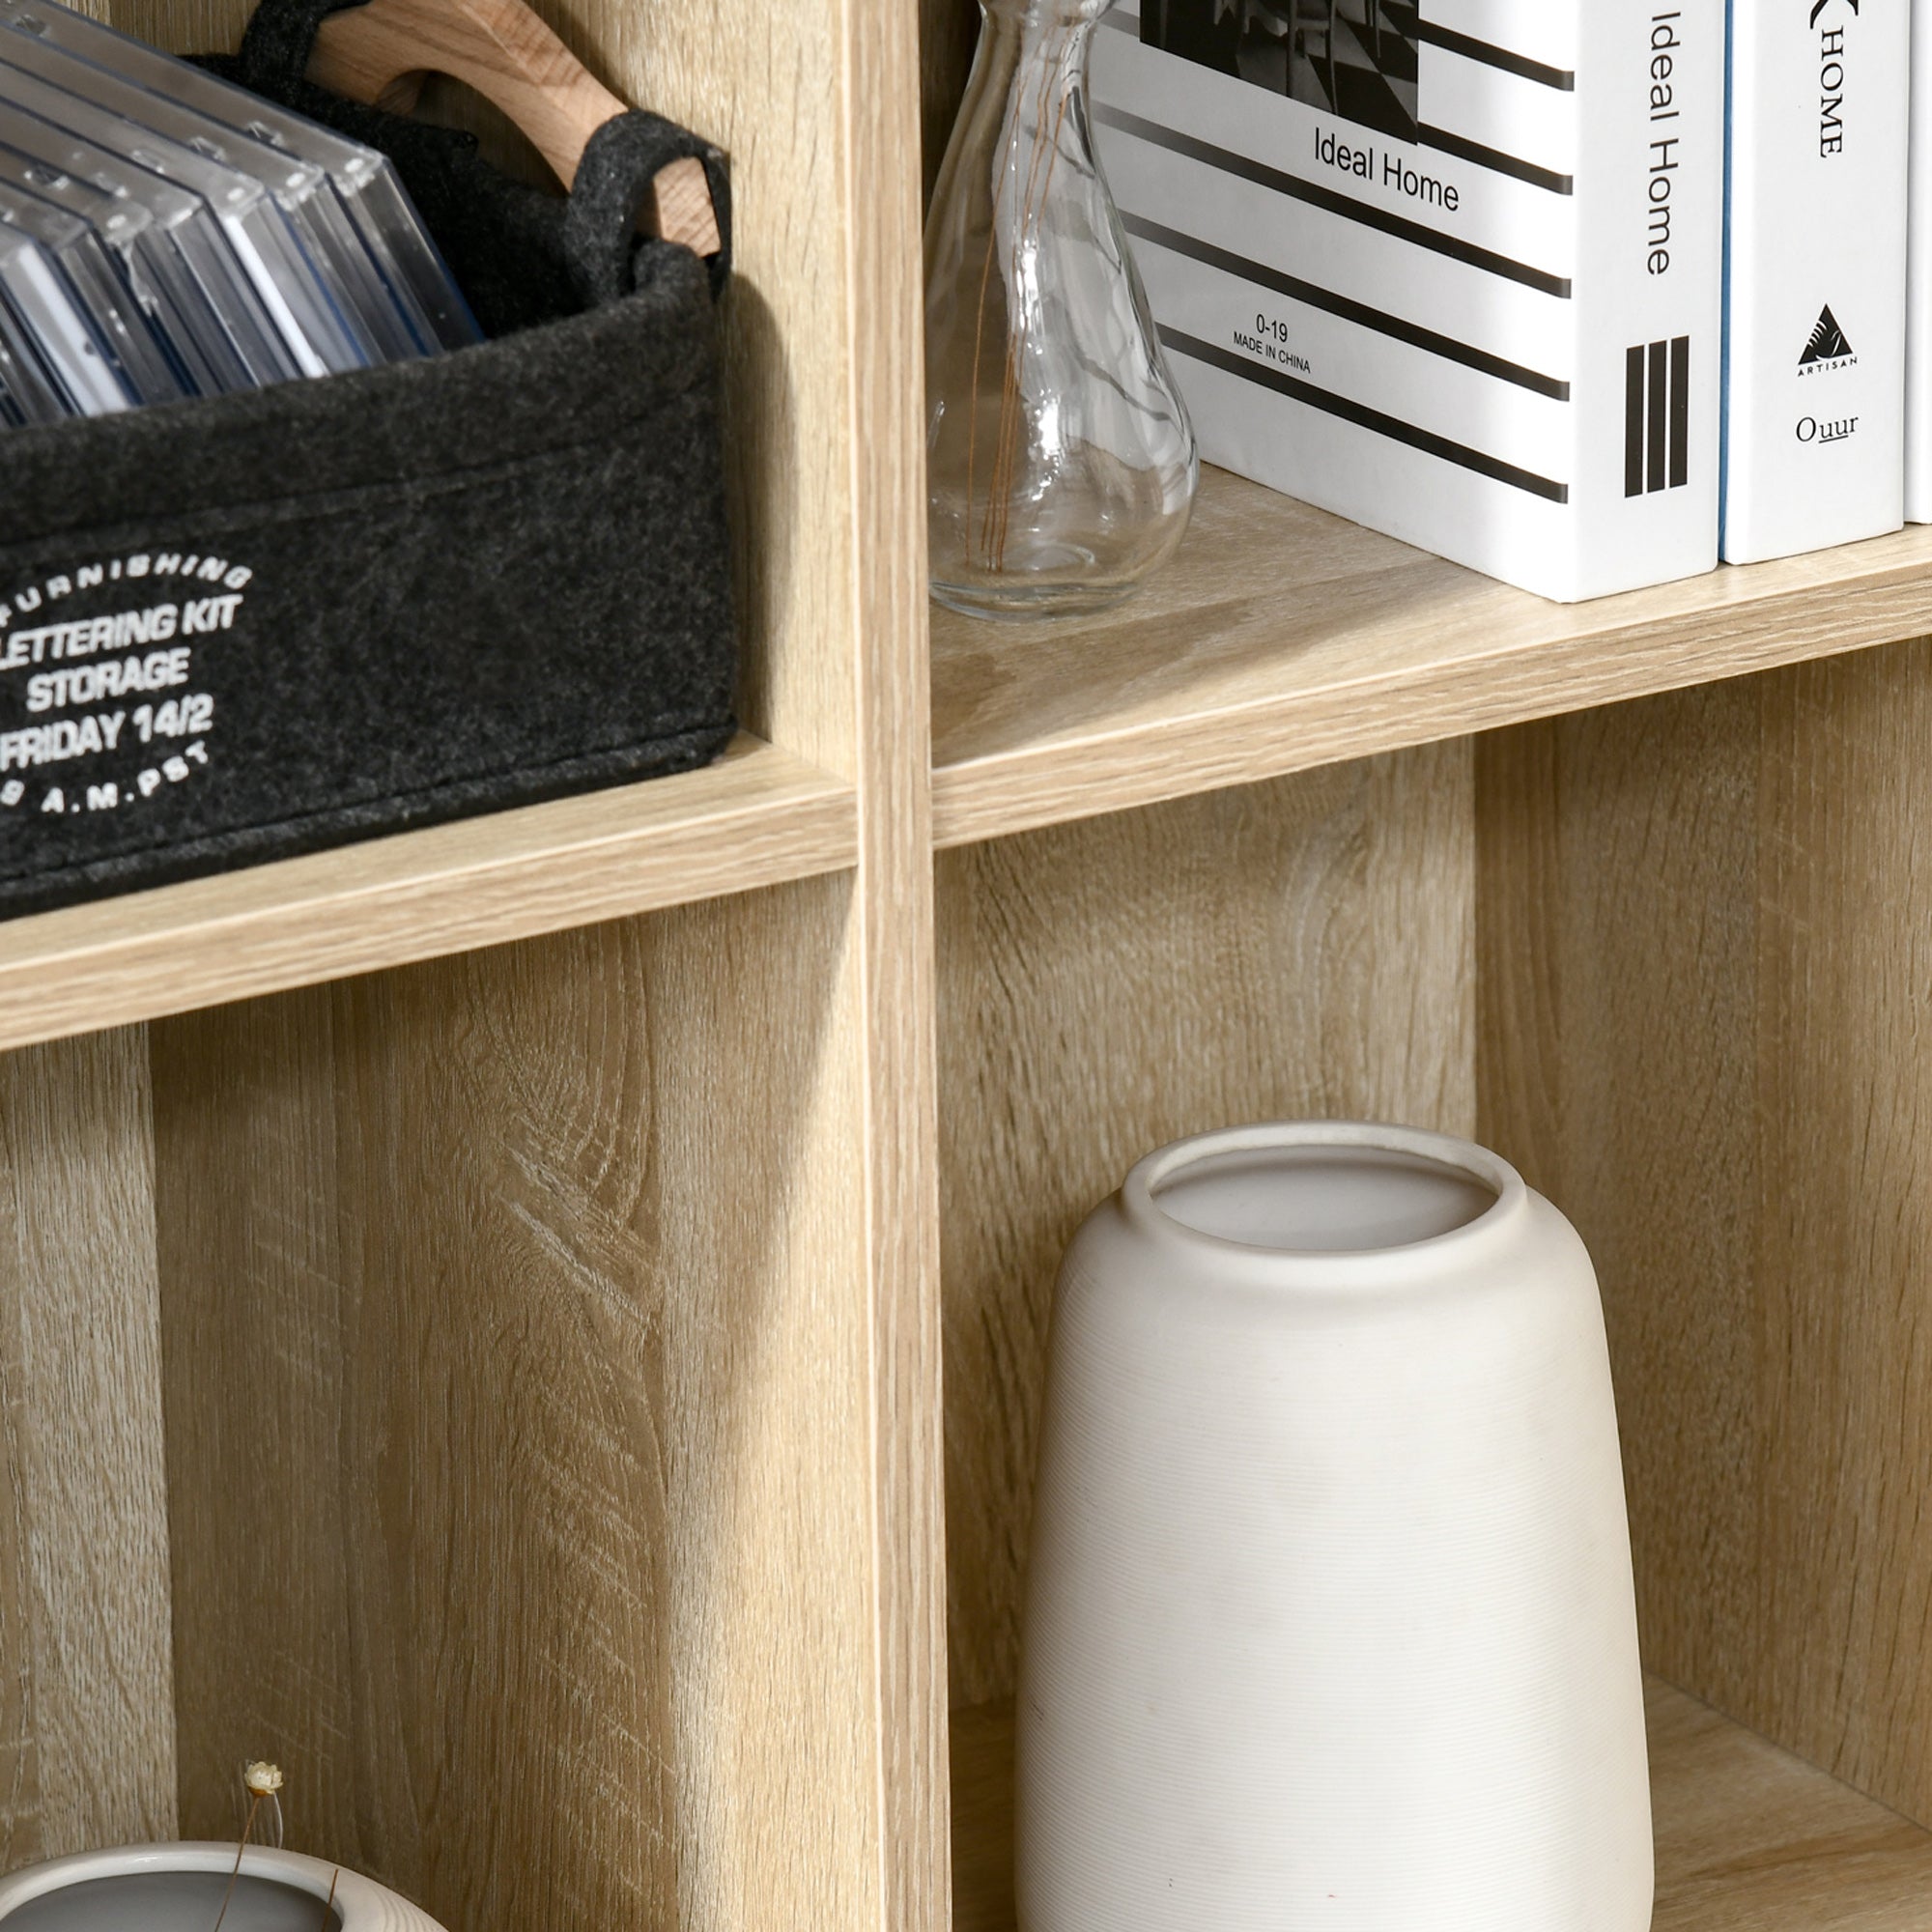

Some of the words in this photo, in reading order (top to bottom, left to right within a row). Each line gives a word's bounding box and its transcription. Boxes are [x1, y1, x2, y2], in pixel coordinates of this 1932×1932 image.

[1650, 12, 1682, 122] Ideal
[1820, 25, 1844, 158] HOME
[1315, 127, 1374, 181] Ideal
[1383, 153, 1459, 212] Home
[1647, 138, 1679, 275] Home
[1233, 330, 1264, 355] MADE
[1265, 344, 1276, 360] IN
[1278, 350, 1311, 375] CHINA
[1256, 313, 1289, 343] 0-19
[1798, 356, 1858, 378] ARTISAN
[1796, 416, 1859, 443] Ouur
[182, 593, 243, 635] KIT
[26, 647, 191, 712] STORAGE
[0, 711, 126, 772] FRIDAY
[132, 693, 213, 743] 14/2
